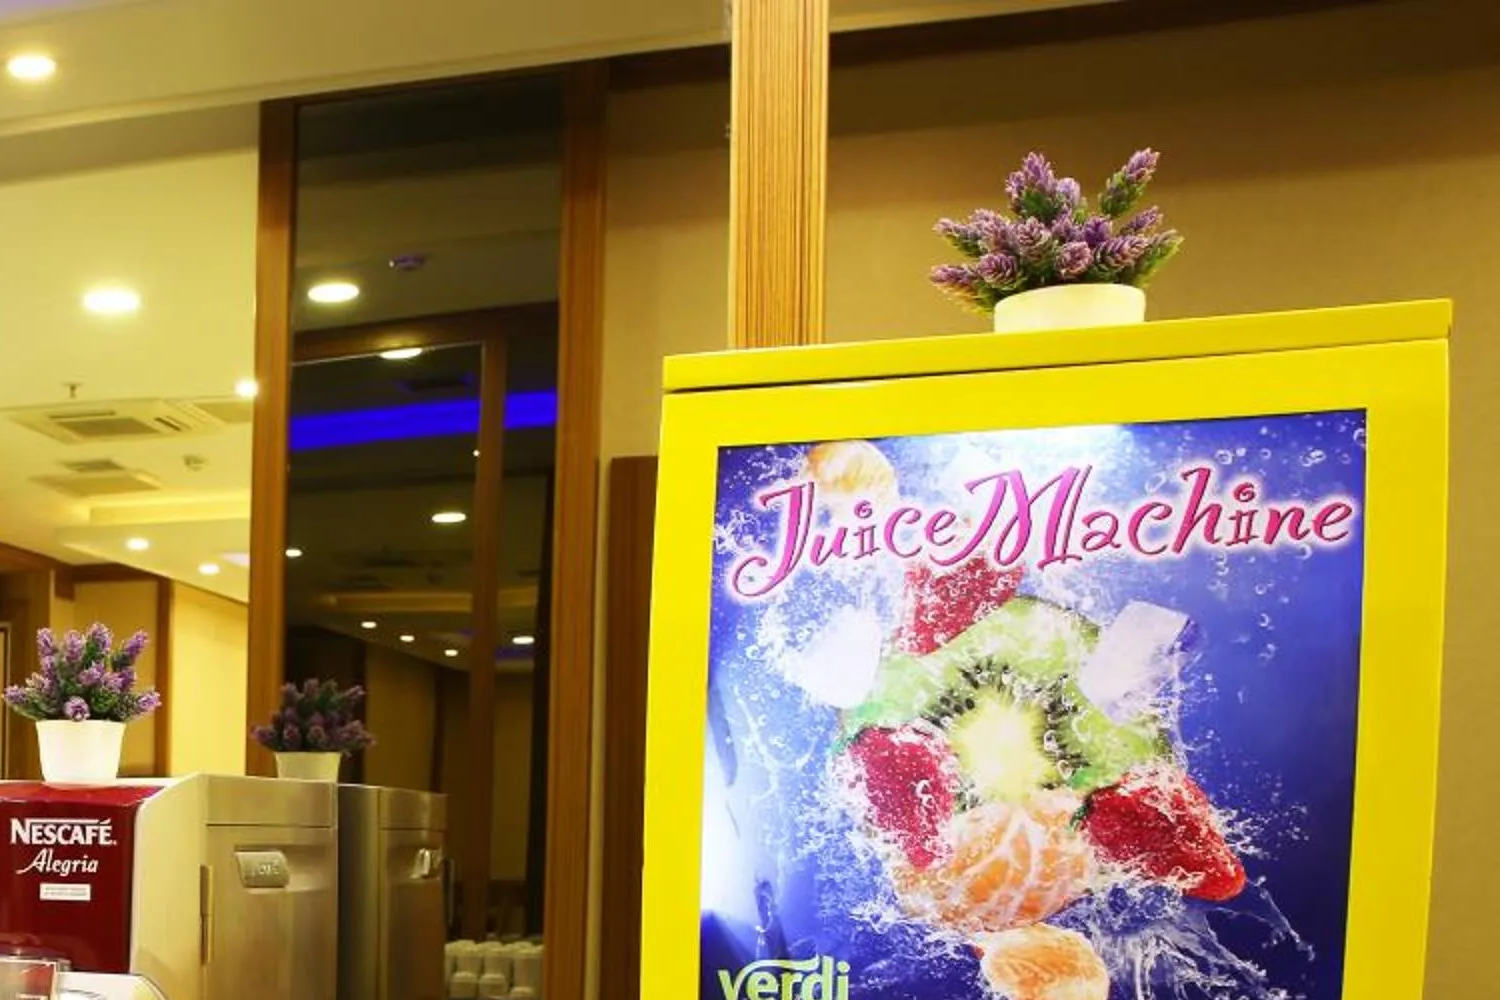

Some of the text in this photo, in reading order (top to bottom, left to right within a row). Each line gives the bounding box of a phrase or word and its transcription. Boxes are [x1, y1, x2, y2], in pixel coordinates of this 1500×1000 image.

[731, 463, 1355, 597] Juice Machine
[10, 818, 113, 845] NESCAFÉ
[16, 848, 99, 877] Alegria
